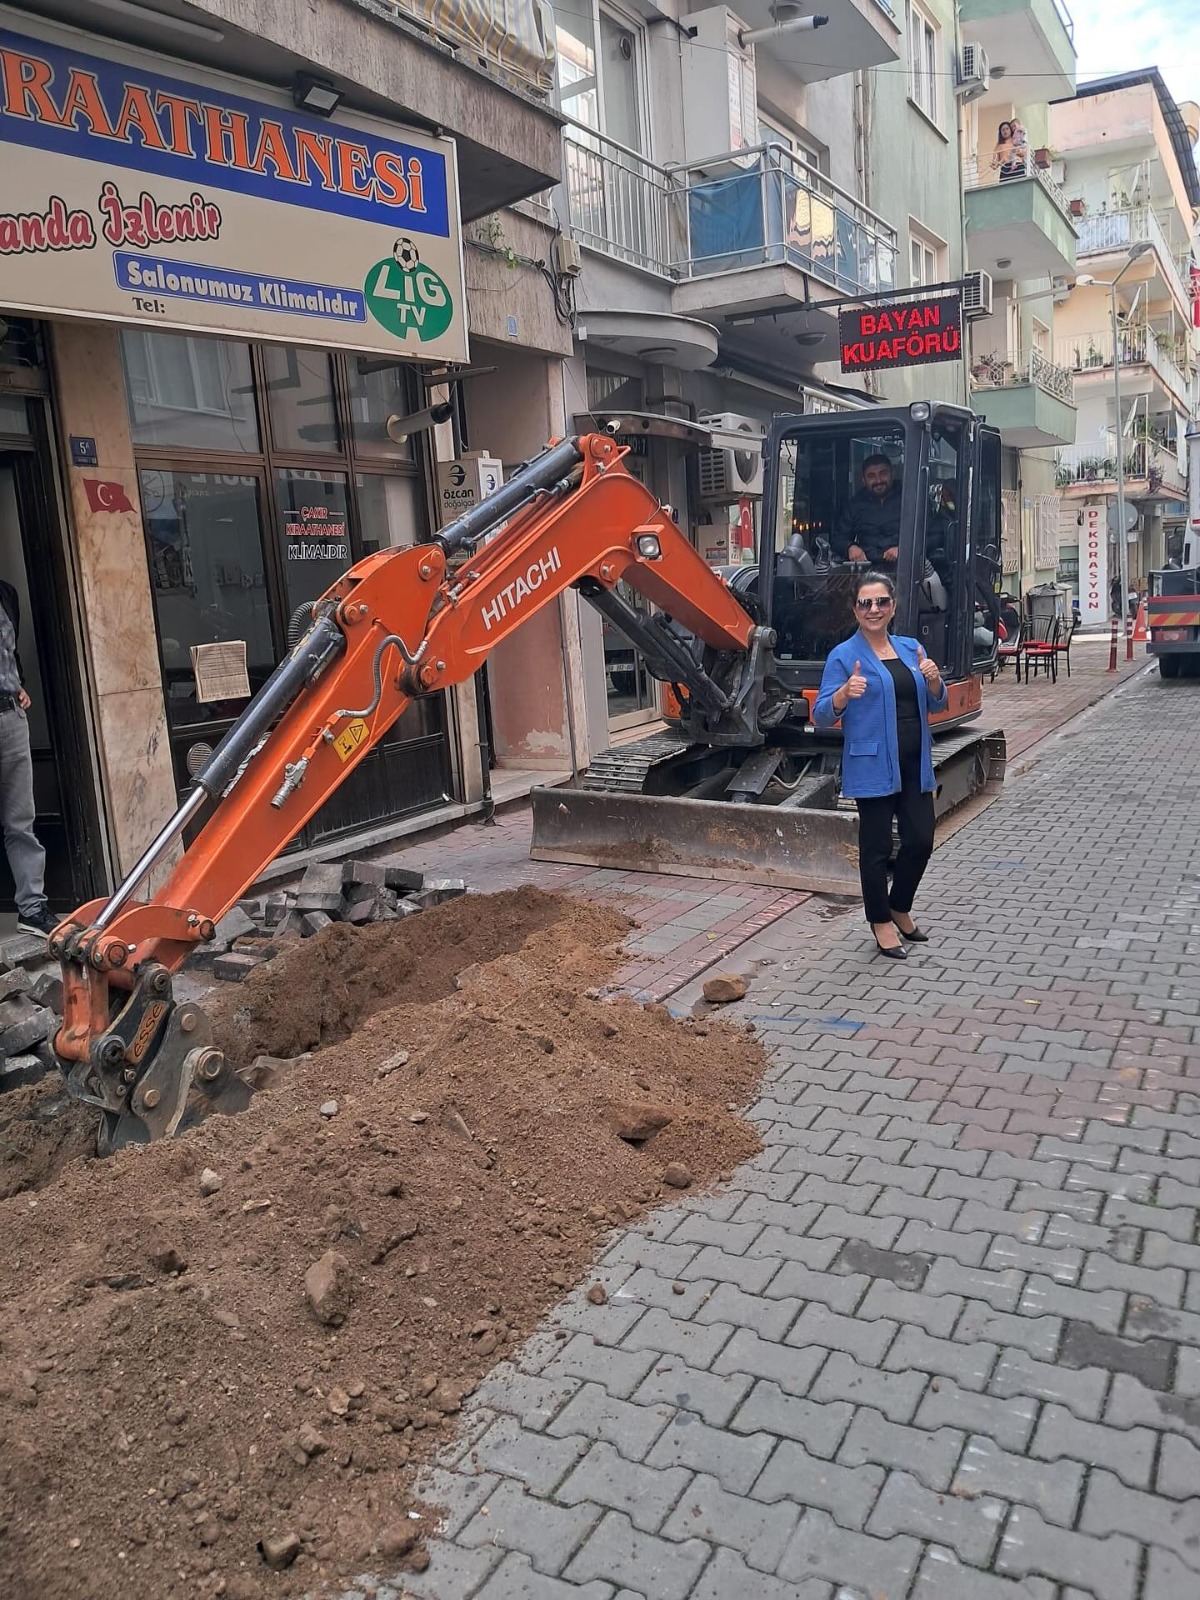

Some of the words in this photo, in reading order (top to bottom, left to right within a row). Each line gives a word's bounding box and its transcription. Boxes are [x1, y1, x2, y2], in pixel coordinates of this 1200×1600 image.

[128, 261, 253, 302] Salonumuz
[259, 282, 358, 316] Klimalıdır
[132, 297, 165, 314] Tel:
[397, 303, 426, 326] TV
[861, 305, 940, 336] BAYAN
[843, 325, 959, 365] KUAFÖRÜ
[444, 489, 474, 499] özcan
[301, 506, 328, 522] ÇAKIR
[444, 500, 475, 511] doğalgaz
[285, 522, 345, 536] KIRAATHANESİ
[288, 541, 348, 560] KLİMALIDIR
[1088, 510, 1099, 610] DEKORASYON
[481, 546, 561, 631] HITACHI
